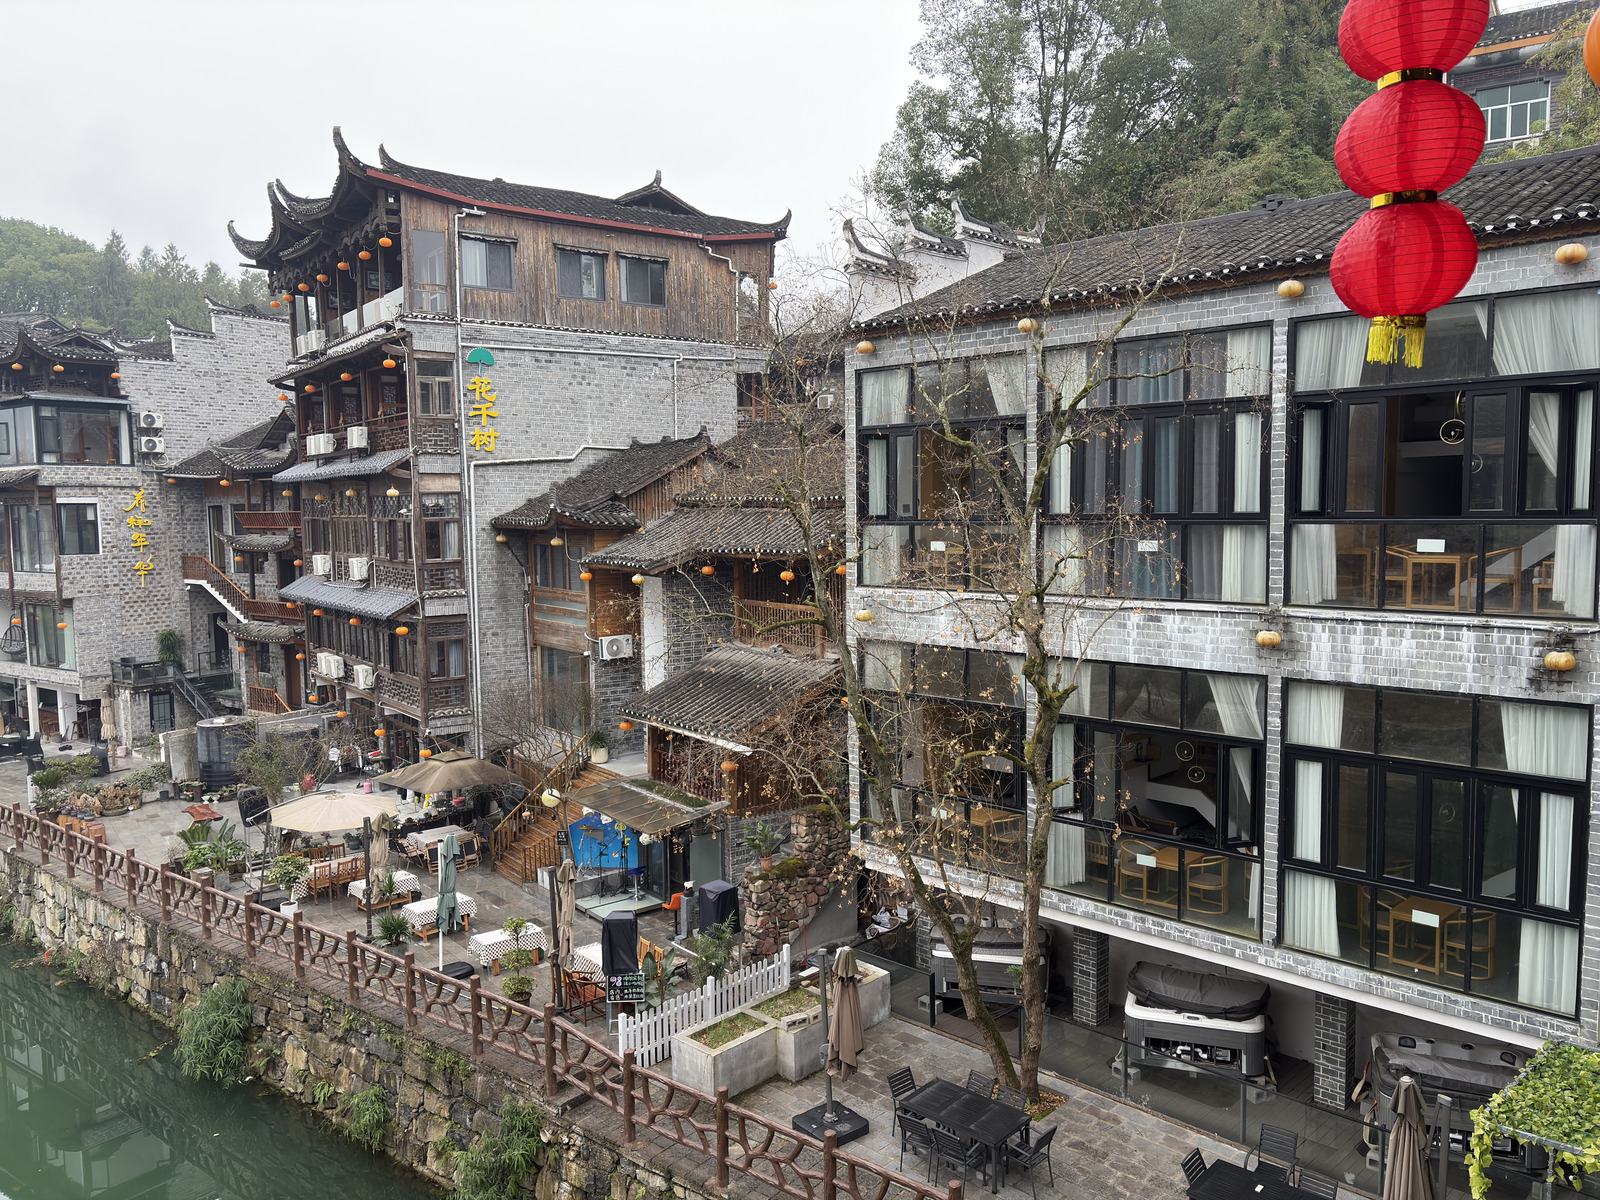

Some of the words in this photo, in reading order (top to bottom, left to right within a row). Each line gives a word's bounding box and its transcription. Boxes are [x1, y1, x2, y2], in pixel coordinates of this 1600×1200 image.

[467, 376, 500, 452] 花千树
[123, 488, 154, 588] 花样年华
[610, 976, 622, 986] 98
